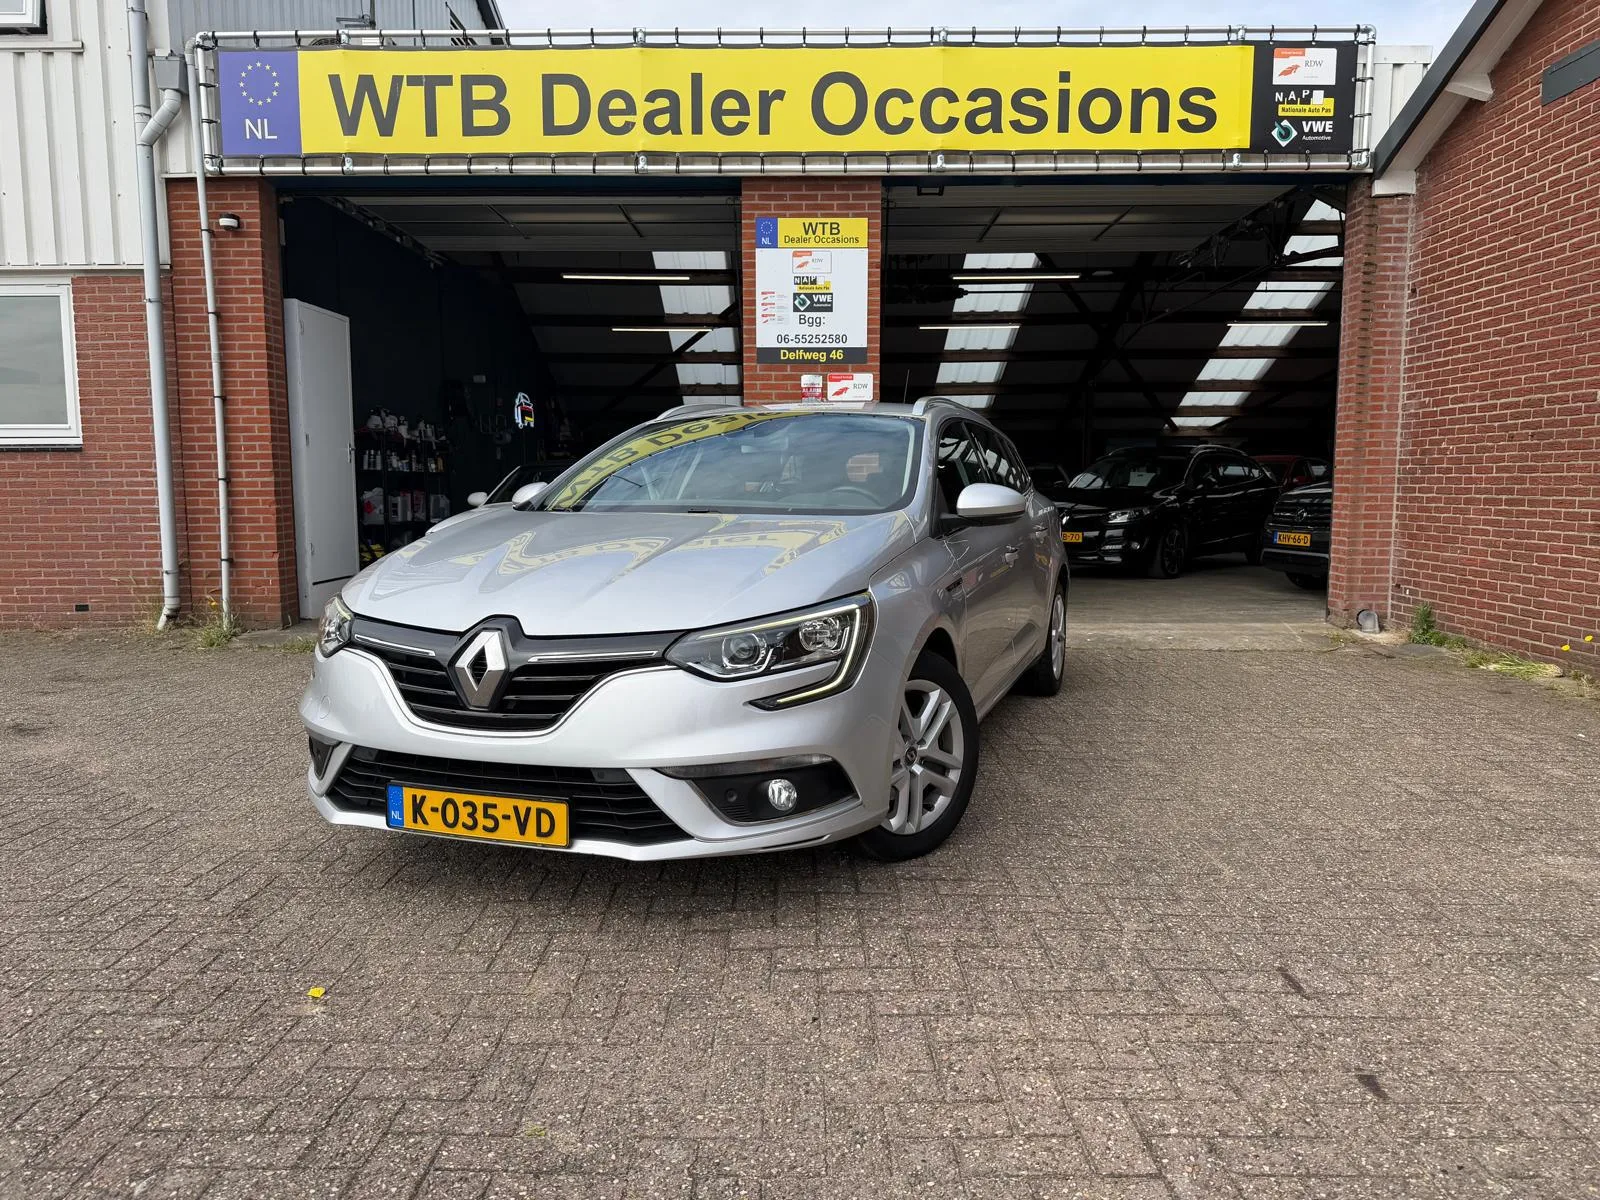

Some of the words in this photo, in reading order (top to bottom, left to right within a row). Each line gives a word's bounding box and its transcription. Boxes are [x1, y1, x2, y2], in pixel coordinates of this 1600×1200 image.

[1304, 60, 1323, 68] RDW
[327, 73, 511, 138] WTB
[541, 72, 786, 137] Dealer
[811, 70, 1218, 136] Occasions
[1281, 106, 1306, 114] Nationale
[244, 118, 278, 140] NL
[1302, 121, 1333, 133] VWE
[803, 222, 840, 236] WTB
[761, 237, 772, 245] NL
[784, 235, 811, 244] Dealer
[814, 235, 860, 244] Occasions
[812, 294, 833, 302] VWE
[798, 314, 826, 327] Bgg:
[776, 334, 848, 344] 06-55252580
[780, 349, 827, 362] Delfweg
[830, 349, 844, 360] 46
[1278, 533, 1309, 545] KHV-66-D
[391, 811, 402, 821] NL
[411, 793, 556, 839] K-035-VD
